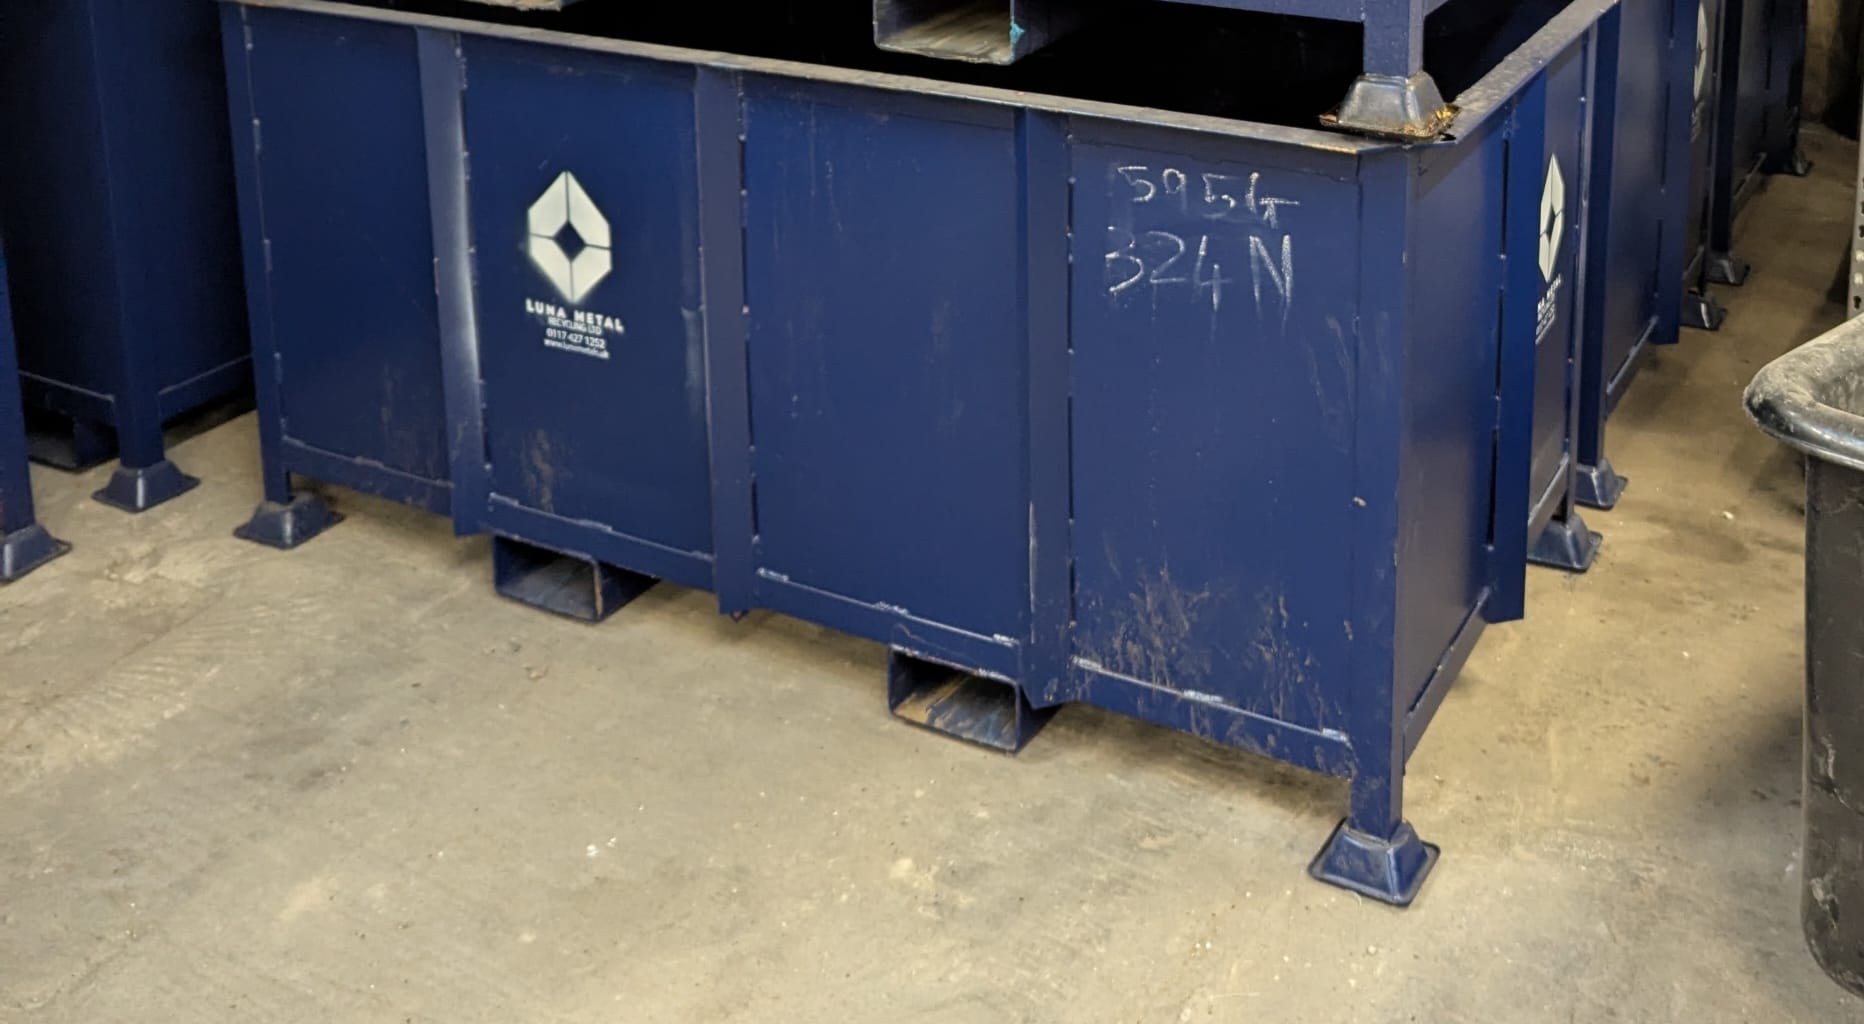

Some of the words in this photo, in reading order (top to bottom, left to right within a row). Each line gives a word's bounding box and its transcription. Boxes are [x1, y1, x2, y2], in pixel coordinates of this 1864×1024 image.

[525, 298, 567, 318] LUNA
[573, 309, 625, 333] METAL
[545, 327, 567, 340] 0117
[584, 336, 606, 350] 1252
